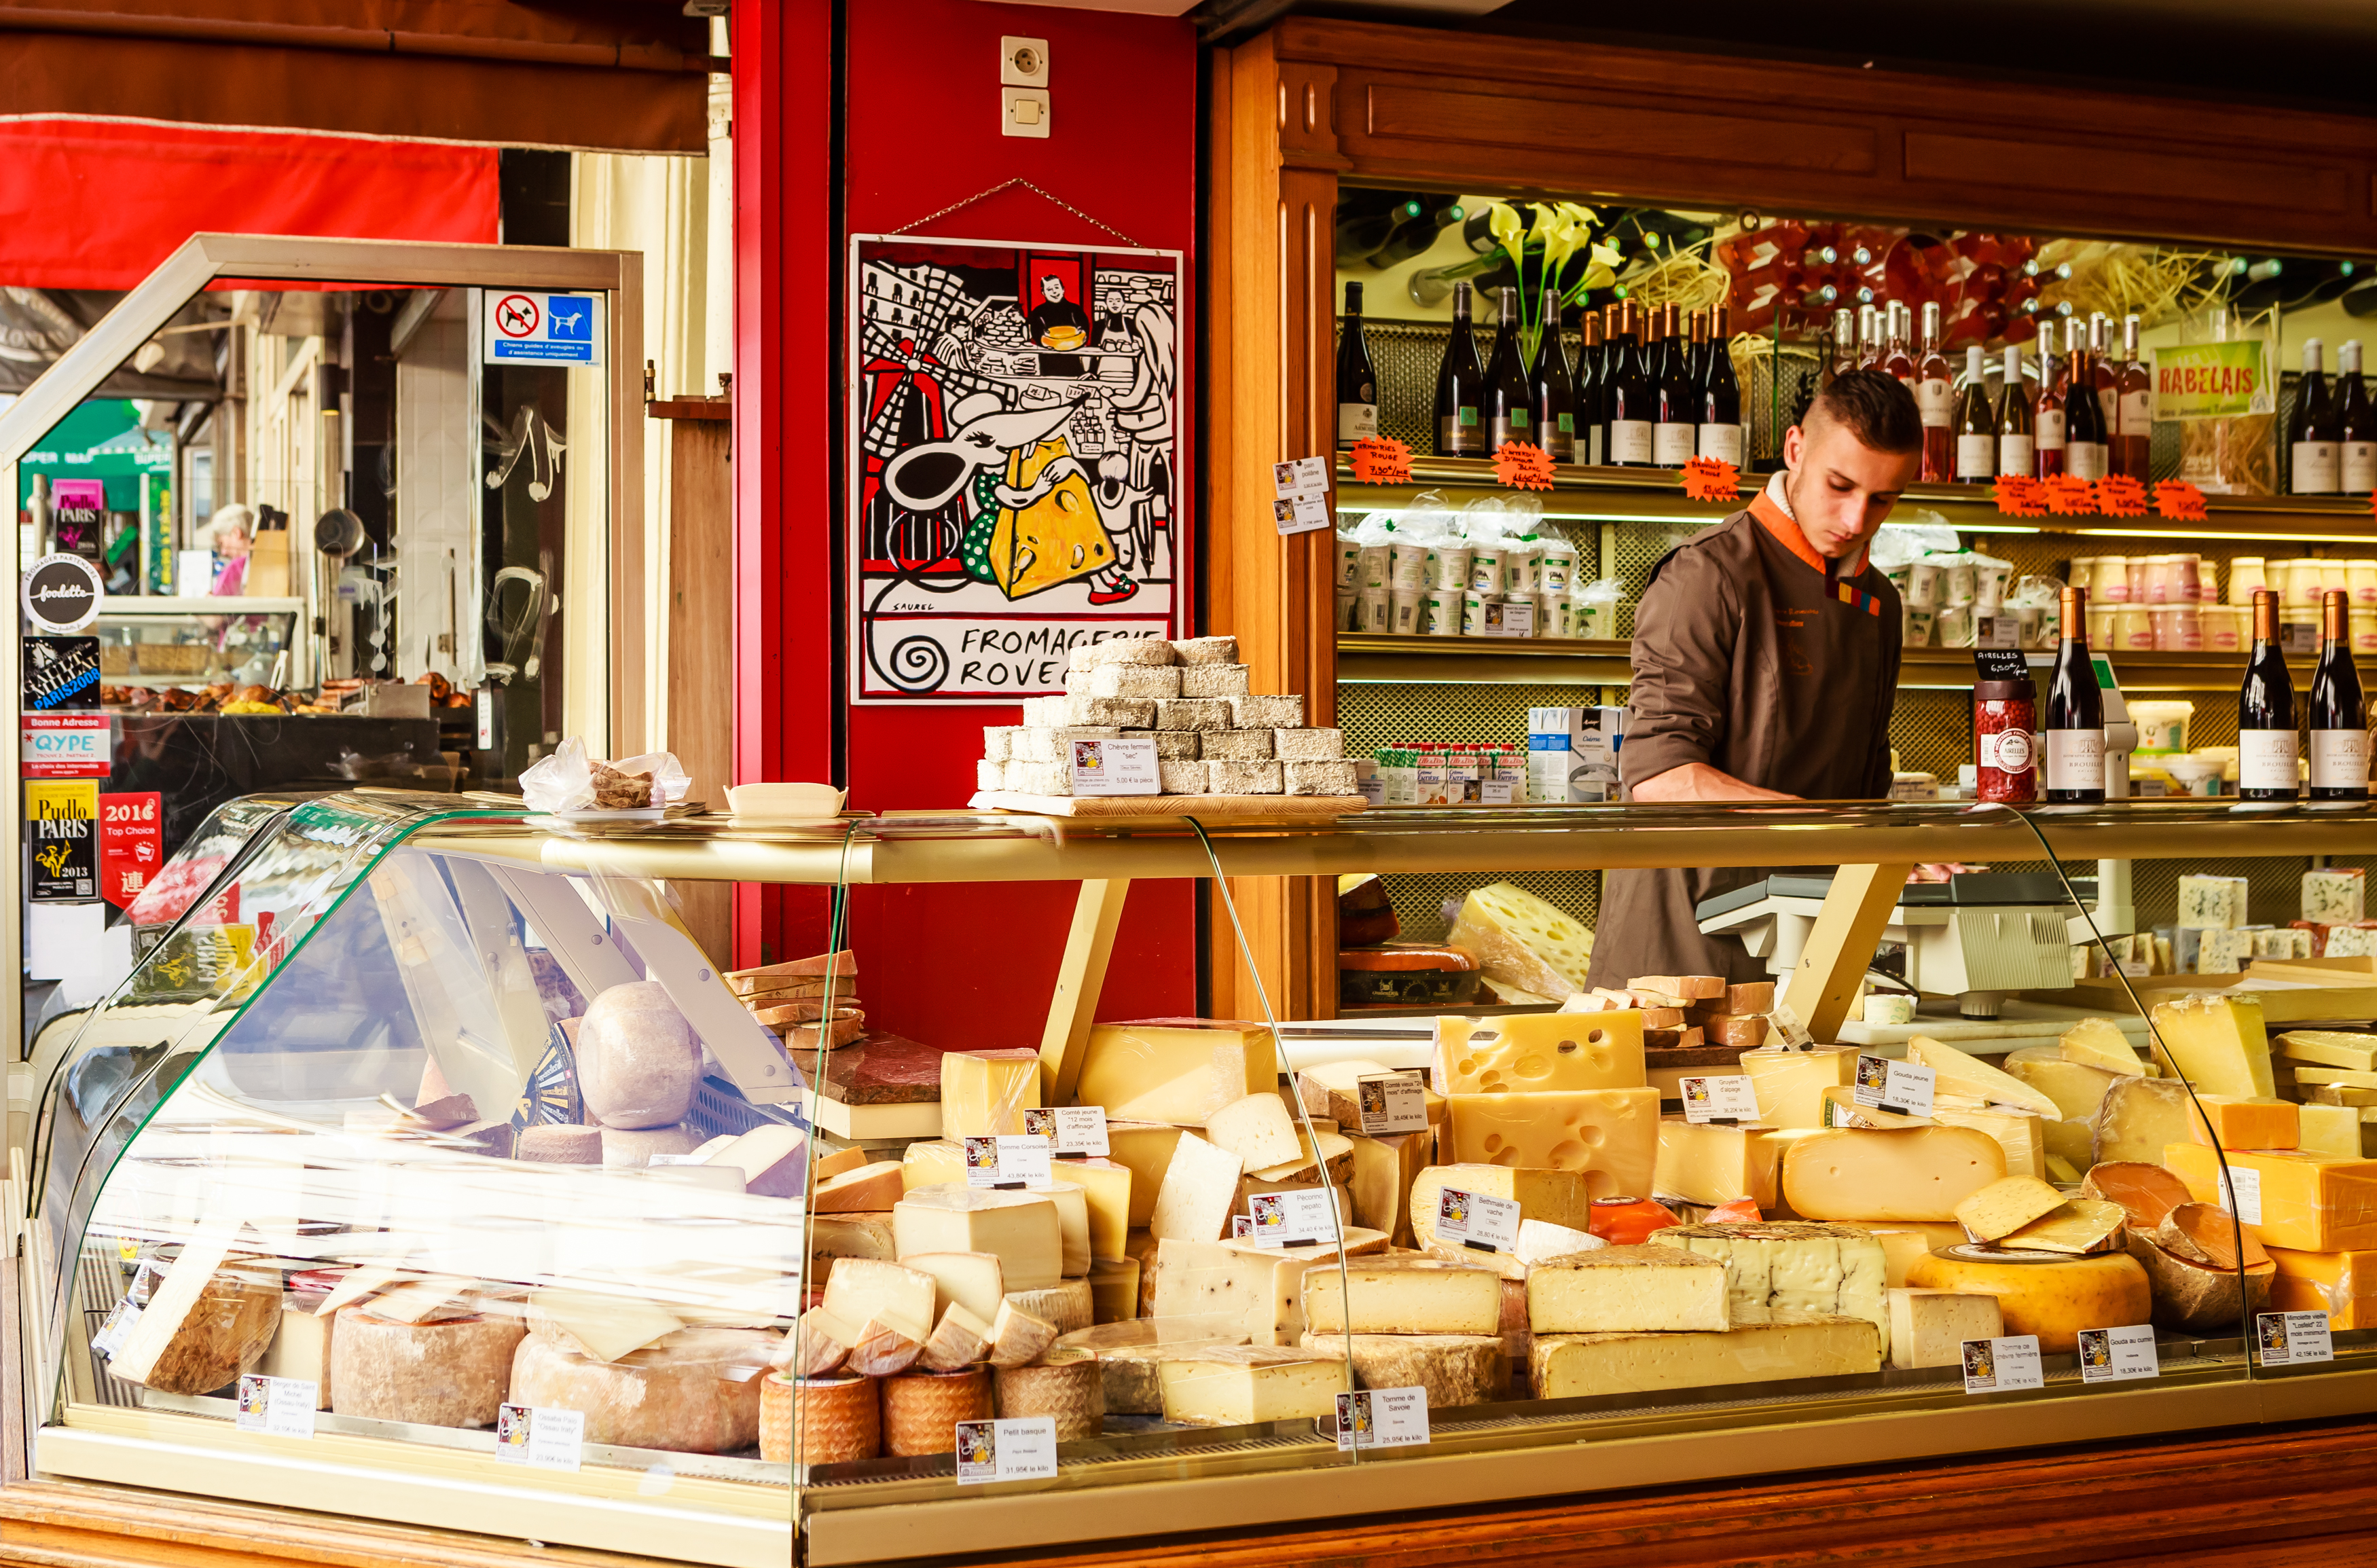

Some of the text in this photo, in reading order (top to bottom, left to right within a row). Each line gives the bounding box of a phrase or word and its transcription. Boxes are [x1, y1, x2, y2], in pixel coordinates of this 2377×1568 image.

[2159, 366, 2253, 396] RABELAIS
[1371, 452, 1398, 461] ROUGE
[1518, 463, 1541, 472] BLANC
[1302, 470, 1320, 478] poilâne
[1699, 469, 1720, 477] ROUGE
[60, 507, 96, 523] PARIS
[25, 555, 57, 582] FROMAGER
[40, 583, 86, 602] foodette
[892, 602, 935, 611] SAUREL
[33, 668, 101, 711] PARIS2008
[31, 718, 99, 727] Bonne Adresse
[35, 734, 96, 752] QYPE
[39, 799, 87, 820] Pudlo
[105, 803, 156, 822] 2016
[39, 818, 88, 839] PARIS
[106, 826, 156, 837] Top Choice
[62, 867, 88, 878] 2013
[1893, 1070, 1929, 1082] Gouda jeune
[1892, 1095, 1910, 1105] 18,30€
[1296, 1193, 1323, 1201] Pécorino
[1301, 1203, 1322, 1211] pepato
[1478, 1197, 1505, 1208] Bethmale
[1486, 1209, 1504, 1217] vache
[2120, 1366, 2137, 1374] 18,30€
[272, 1379, 291, 1389] Berger
[302, 1383, 316, 1391] Saint
[284, 1390, 303, 1398] Michel
[274, 1398, 311, 1410] (Ossau-Iraty)
[1388, 1404, 1411, 1412] Savoie
[539, 1413, 562, 1422] Ossaba
[1003, 1428, 1047, 1437] Petit basque
[563, 1457, 574, 1465] kilo
